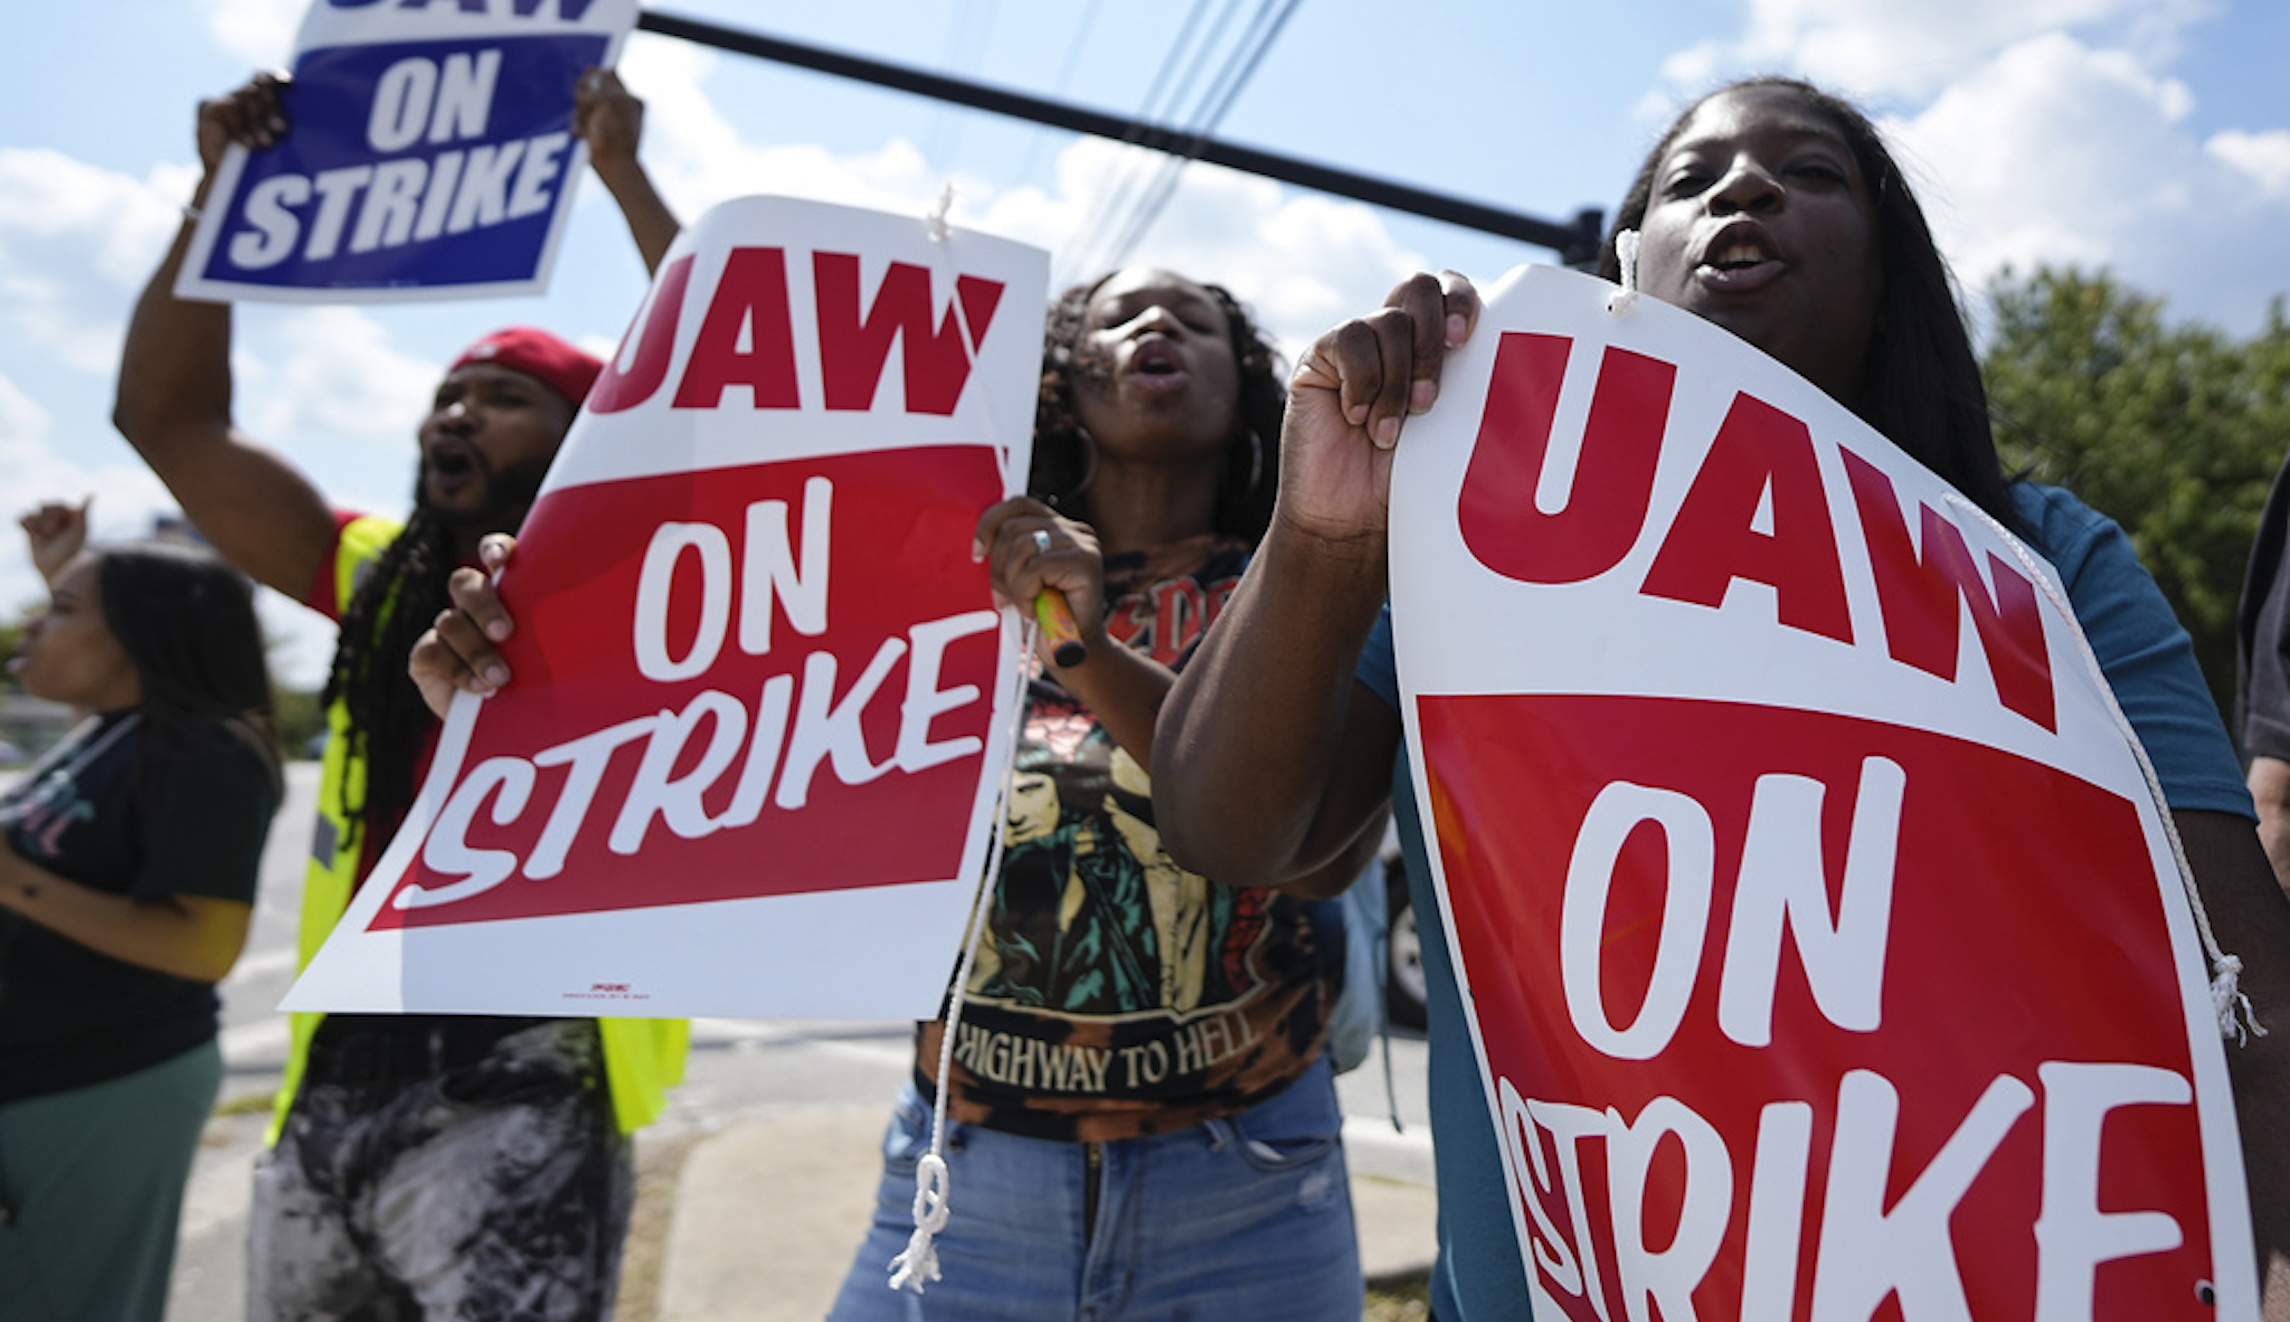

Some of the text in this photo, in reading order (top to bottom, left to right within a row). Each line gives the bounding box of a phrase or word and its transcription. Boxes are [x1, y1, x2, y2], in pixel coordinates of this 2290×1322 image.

[366, 49, 502, 153] ON
[228, 131, 570, 271] STRIKE
[587, 246, 1006, 417] UAW
[633, 475, 834, 682] ON
[1456, 331, 2058, 736] UAW
[392, 610, 999, 910] STRIKE
[1560, 755, 1907, 1061] ON
[953, 1009, 1263, 1093] HIGHWAY TO HELL
